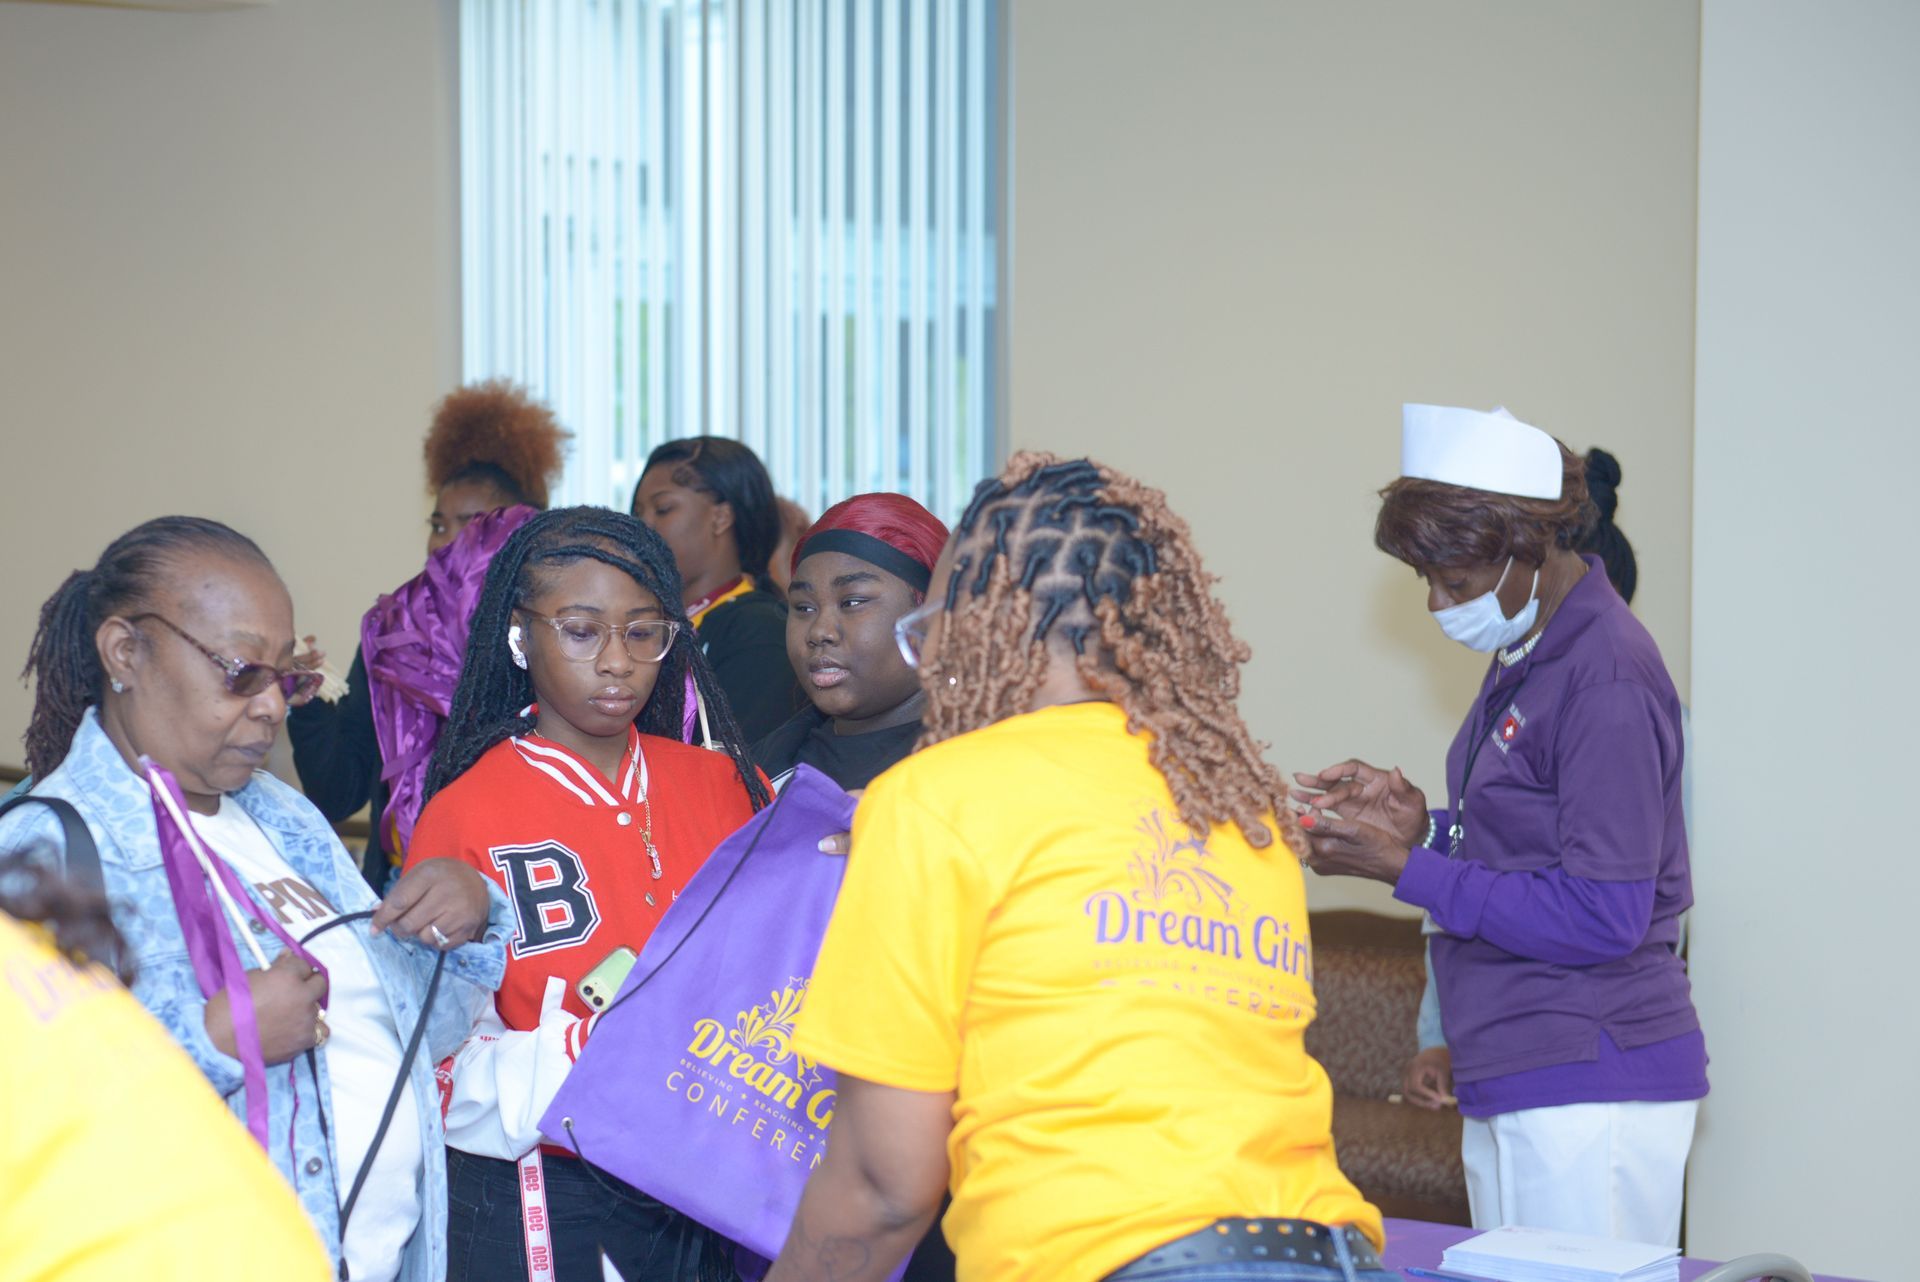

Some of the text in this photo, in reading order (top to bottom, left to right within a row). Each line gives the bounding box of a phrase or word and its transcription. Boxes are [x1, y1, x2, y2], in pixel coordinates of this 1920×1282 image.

[488, 839, 601, 960] B
[1085, 891, 1243, 960] Dream
[680, 1057, 805, 1134] BELIEVING REACHING
[687, 1018, 803, 1110] Dream
